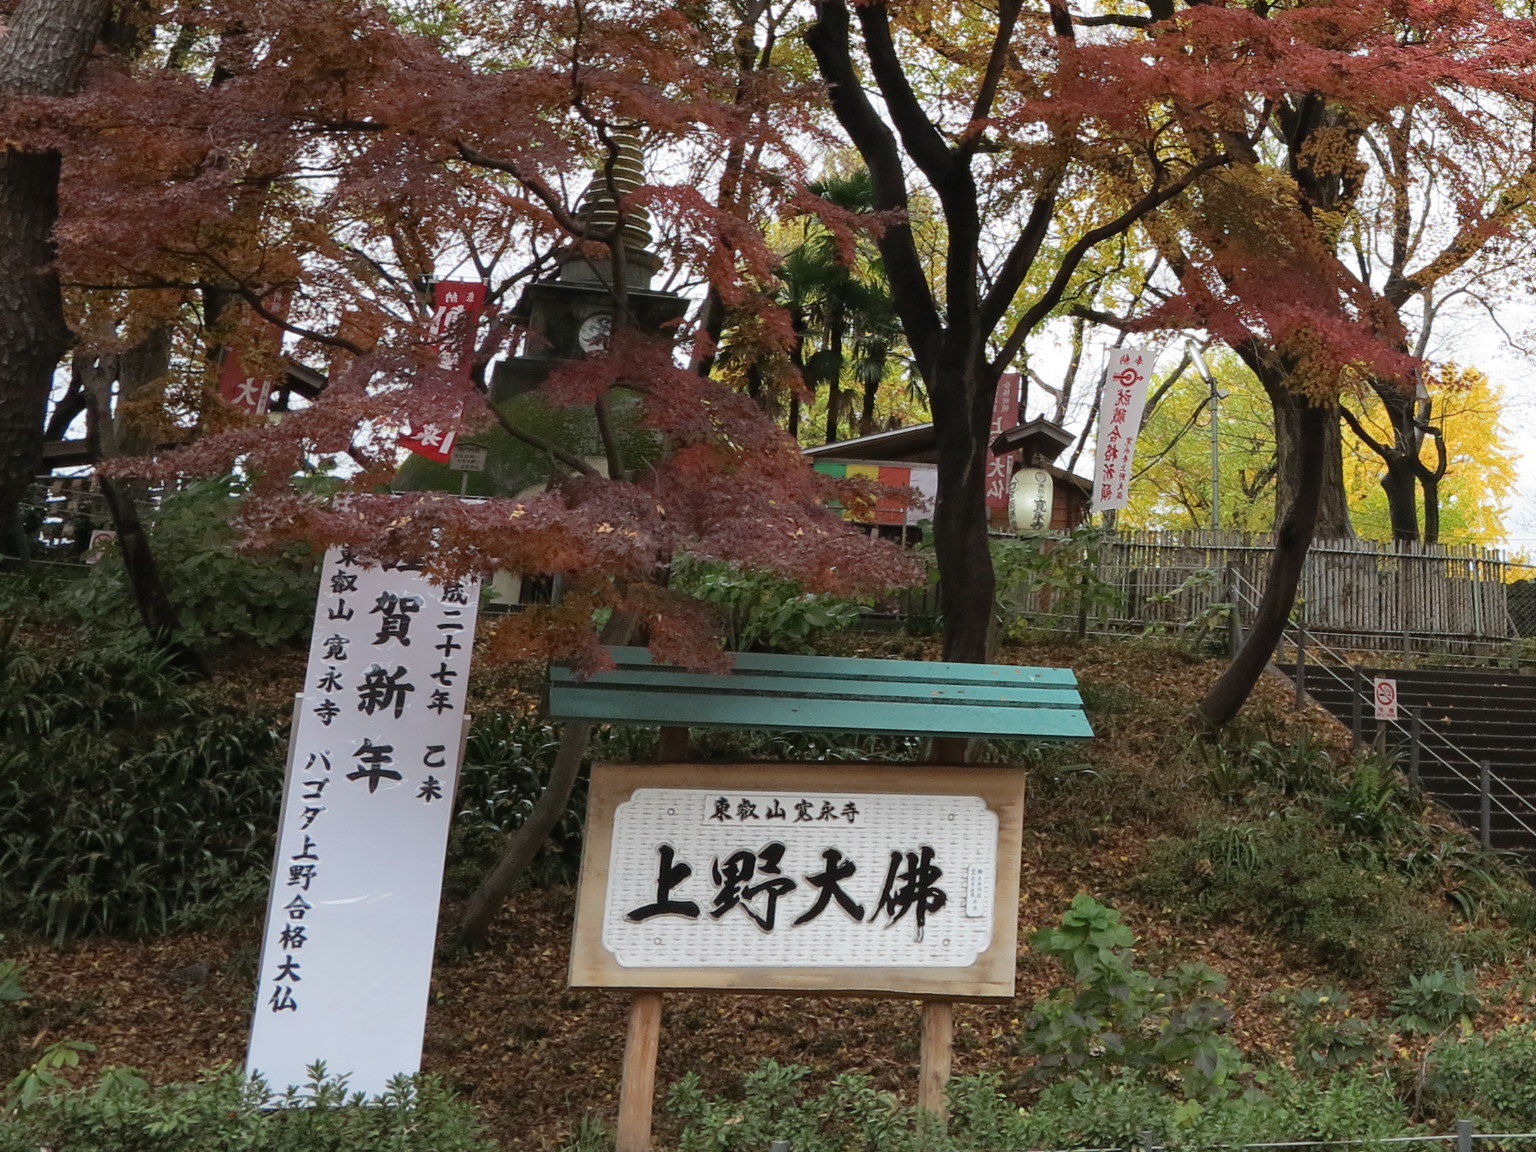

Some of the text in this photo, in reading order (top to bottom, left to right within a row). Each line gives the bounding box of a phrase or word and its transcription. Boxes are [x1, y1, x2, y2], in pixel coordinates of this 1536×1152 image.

[345, 557, 425, 795] 賀新年
[414, 581, 469, 804] 成二十七年 乙未
[622, 840, 948, 944] 上野大佛
